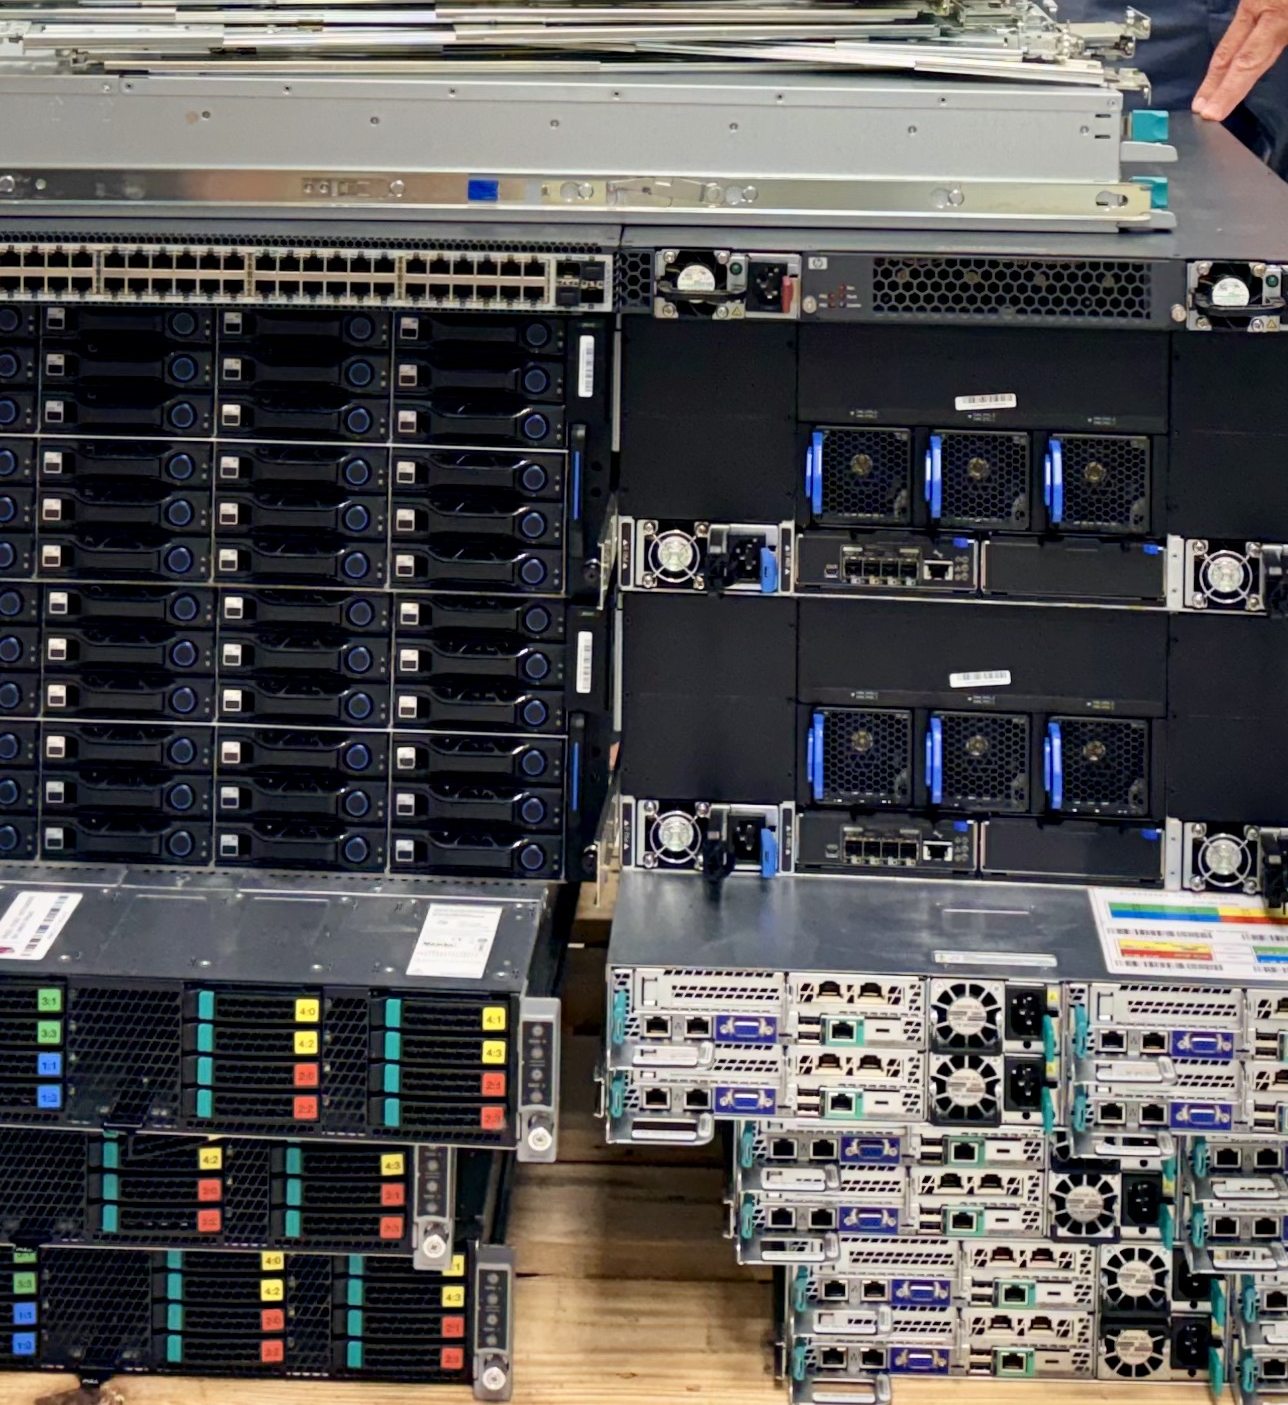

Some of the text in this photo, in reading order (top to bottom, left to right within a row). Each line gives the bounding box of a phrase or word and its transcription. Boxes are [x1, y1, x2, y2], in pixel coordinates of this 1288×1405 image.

[41, 996, 57, 1006] 3:1
[299, 1007, 316, 1016] 4:0
[486, 1015, 502, 1024] 4:1
[41, 1028, 57, 1039] 3:3
[298, 1039, 315, 1049] 4:2
[486, 1048, 503, 1058] 4:3
[41, 1061, 57, 1070] 1:1
[486, 1081, 501, 1090] 2:1
[297, 1104, 314, 1114] 2:2
[202, 1155, 219, 1164] 4:2
[385, 1161, 401, 1170] 4:3
[385, 1191, 400, 1200] 2:1
[265, 1256, 282, 1265] 4:0
[264, 1286, 281, 1296] 4:2
[445, 1293, 462, 1302] 4:3
[445, 1323, 463, 1333] 2:1
